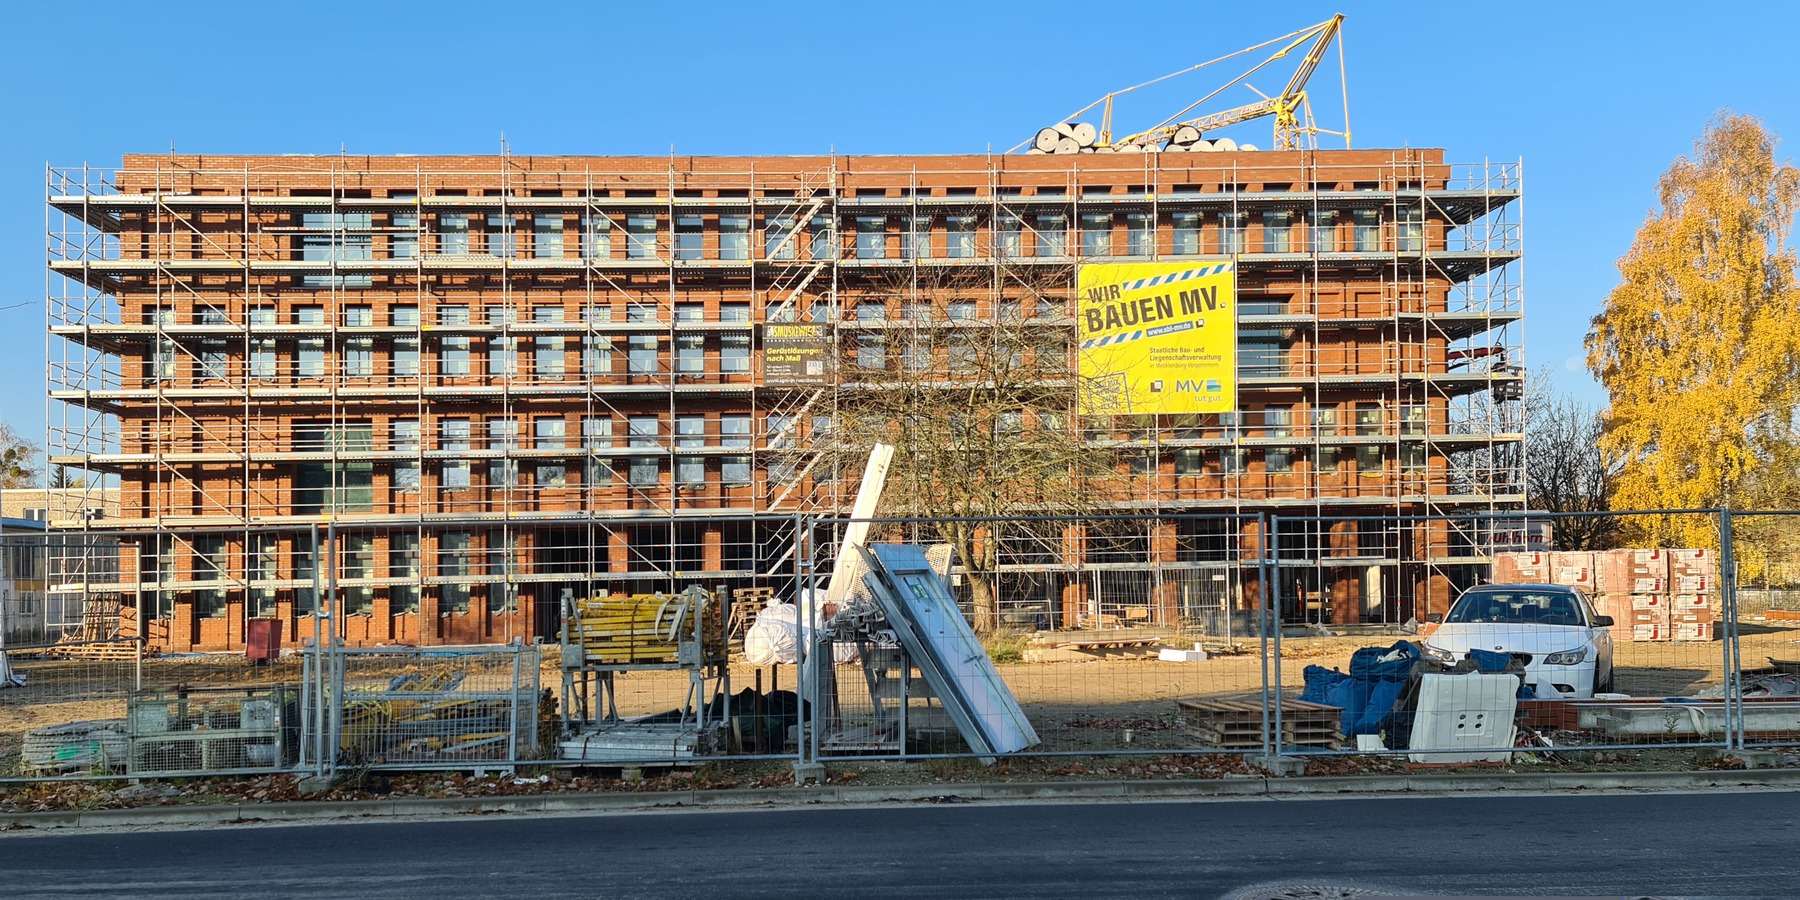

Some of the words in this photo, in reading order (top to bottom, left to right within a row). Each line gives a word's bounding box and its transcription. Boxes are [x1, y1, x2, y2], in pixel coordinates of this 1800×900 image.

[1088, 284, 1121, 304] WIR
[1086, 294, 1174, 333] BAUEN
[1149, 354, 1222, 362] Liegenschaftsverwaltung
[1175, 380, 1204, 393] MV
